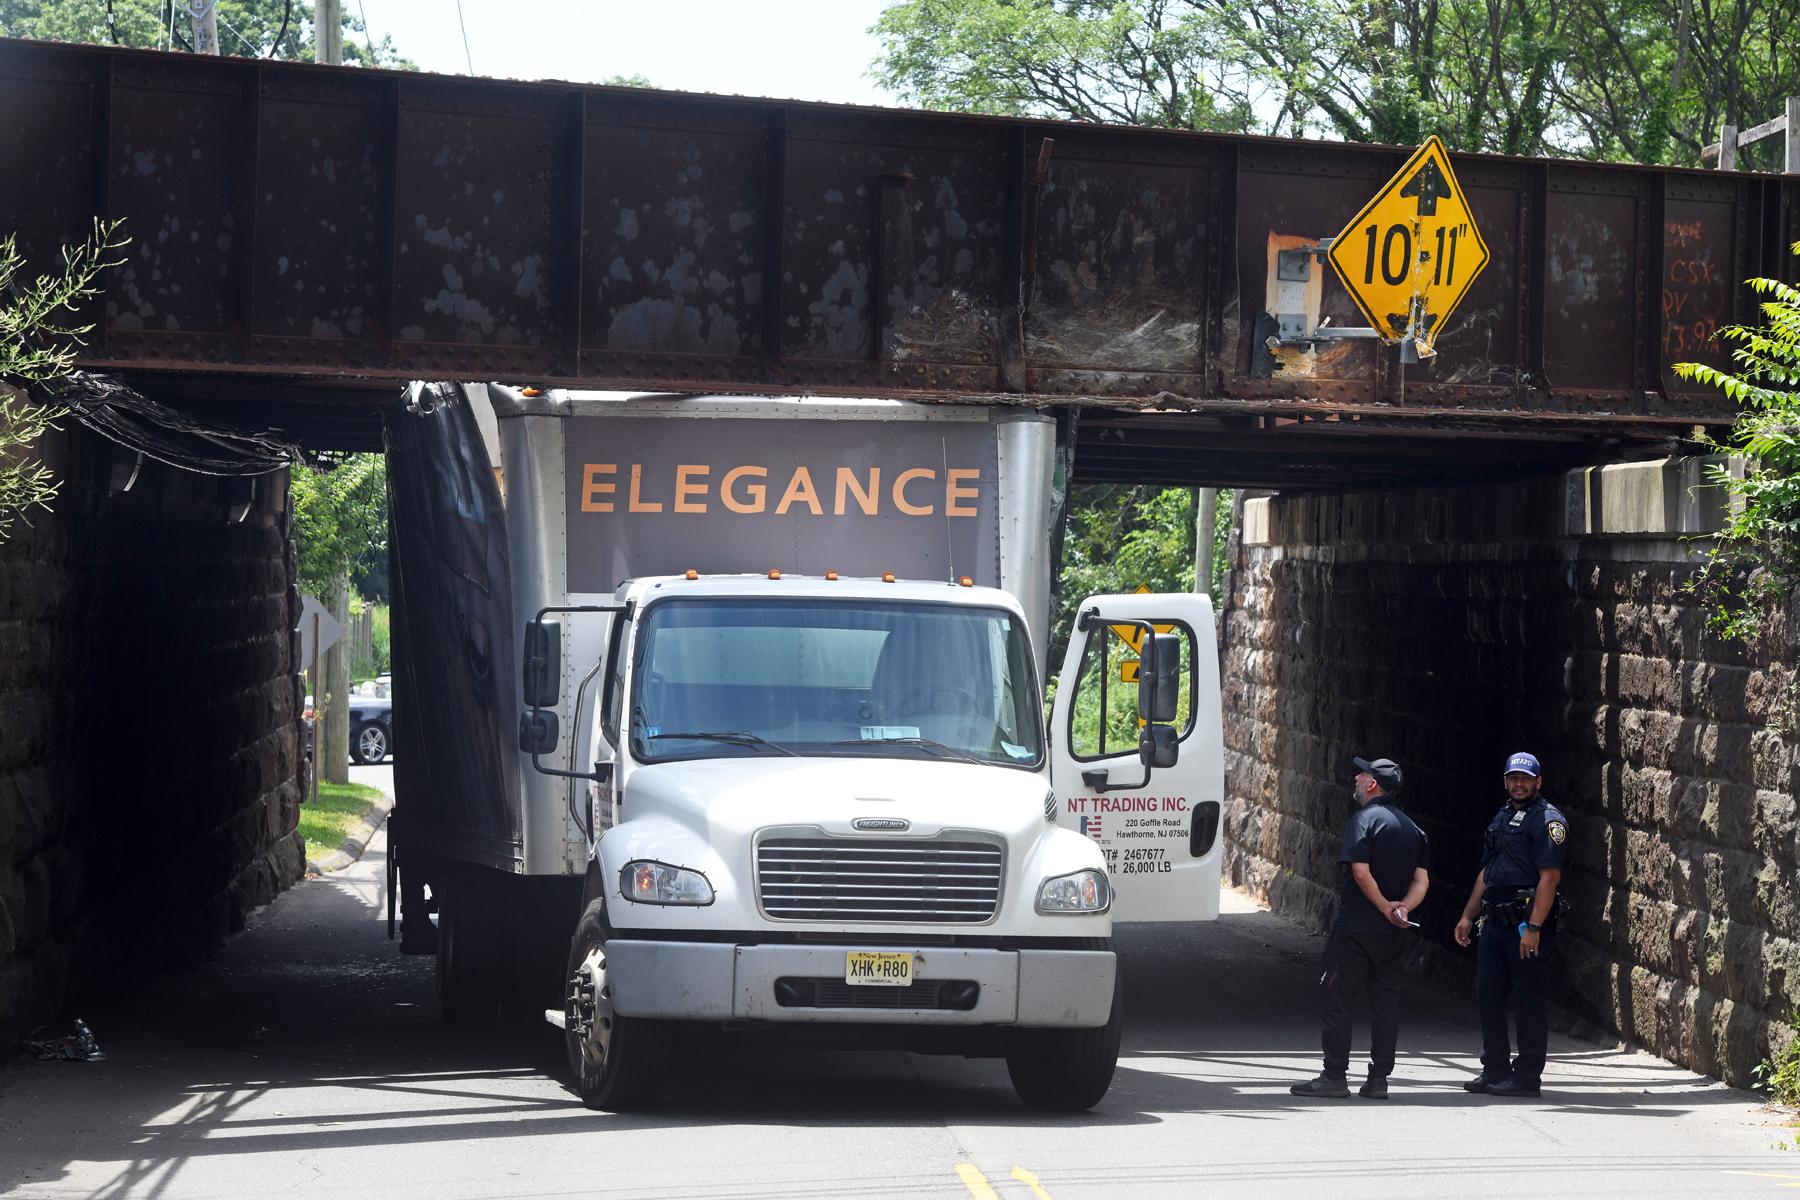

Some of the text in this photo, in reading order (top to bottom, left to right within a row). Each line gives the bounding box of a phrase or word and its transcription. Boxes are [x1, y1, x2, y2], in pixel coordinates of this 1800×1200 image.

[581, 464, 981, 517] ELEGANCE
[1067, 797, 1191, 813] NT TRADING INC.
[1125, 819, 1138, 827] 220
[1162, 818, 1181, 827] Road
[1116, 829, 1189, 839] Hawthorne, NJ 07506
[1124, 849, 1165, 860] 2467677
[1122, 861, 1155, 875] 26,000
[1157, 861, 1172, 873] LB
[851, 960, 908, 978] XHK R80
